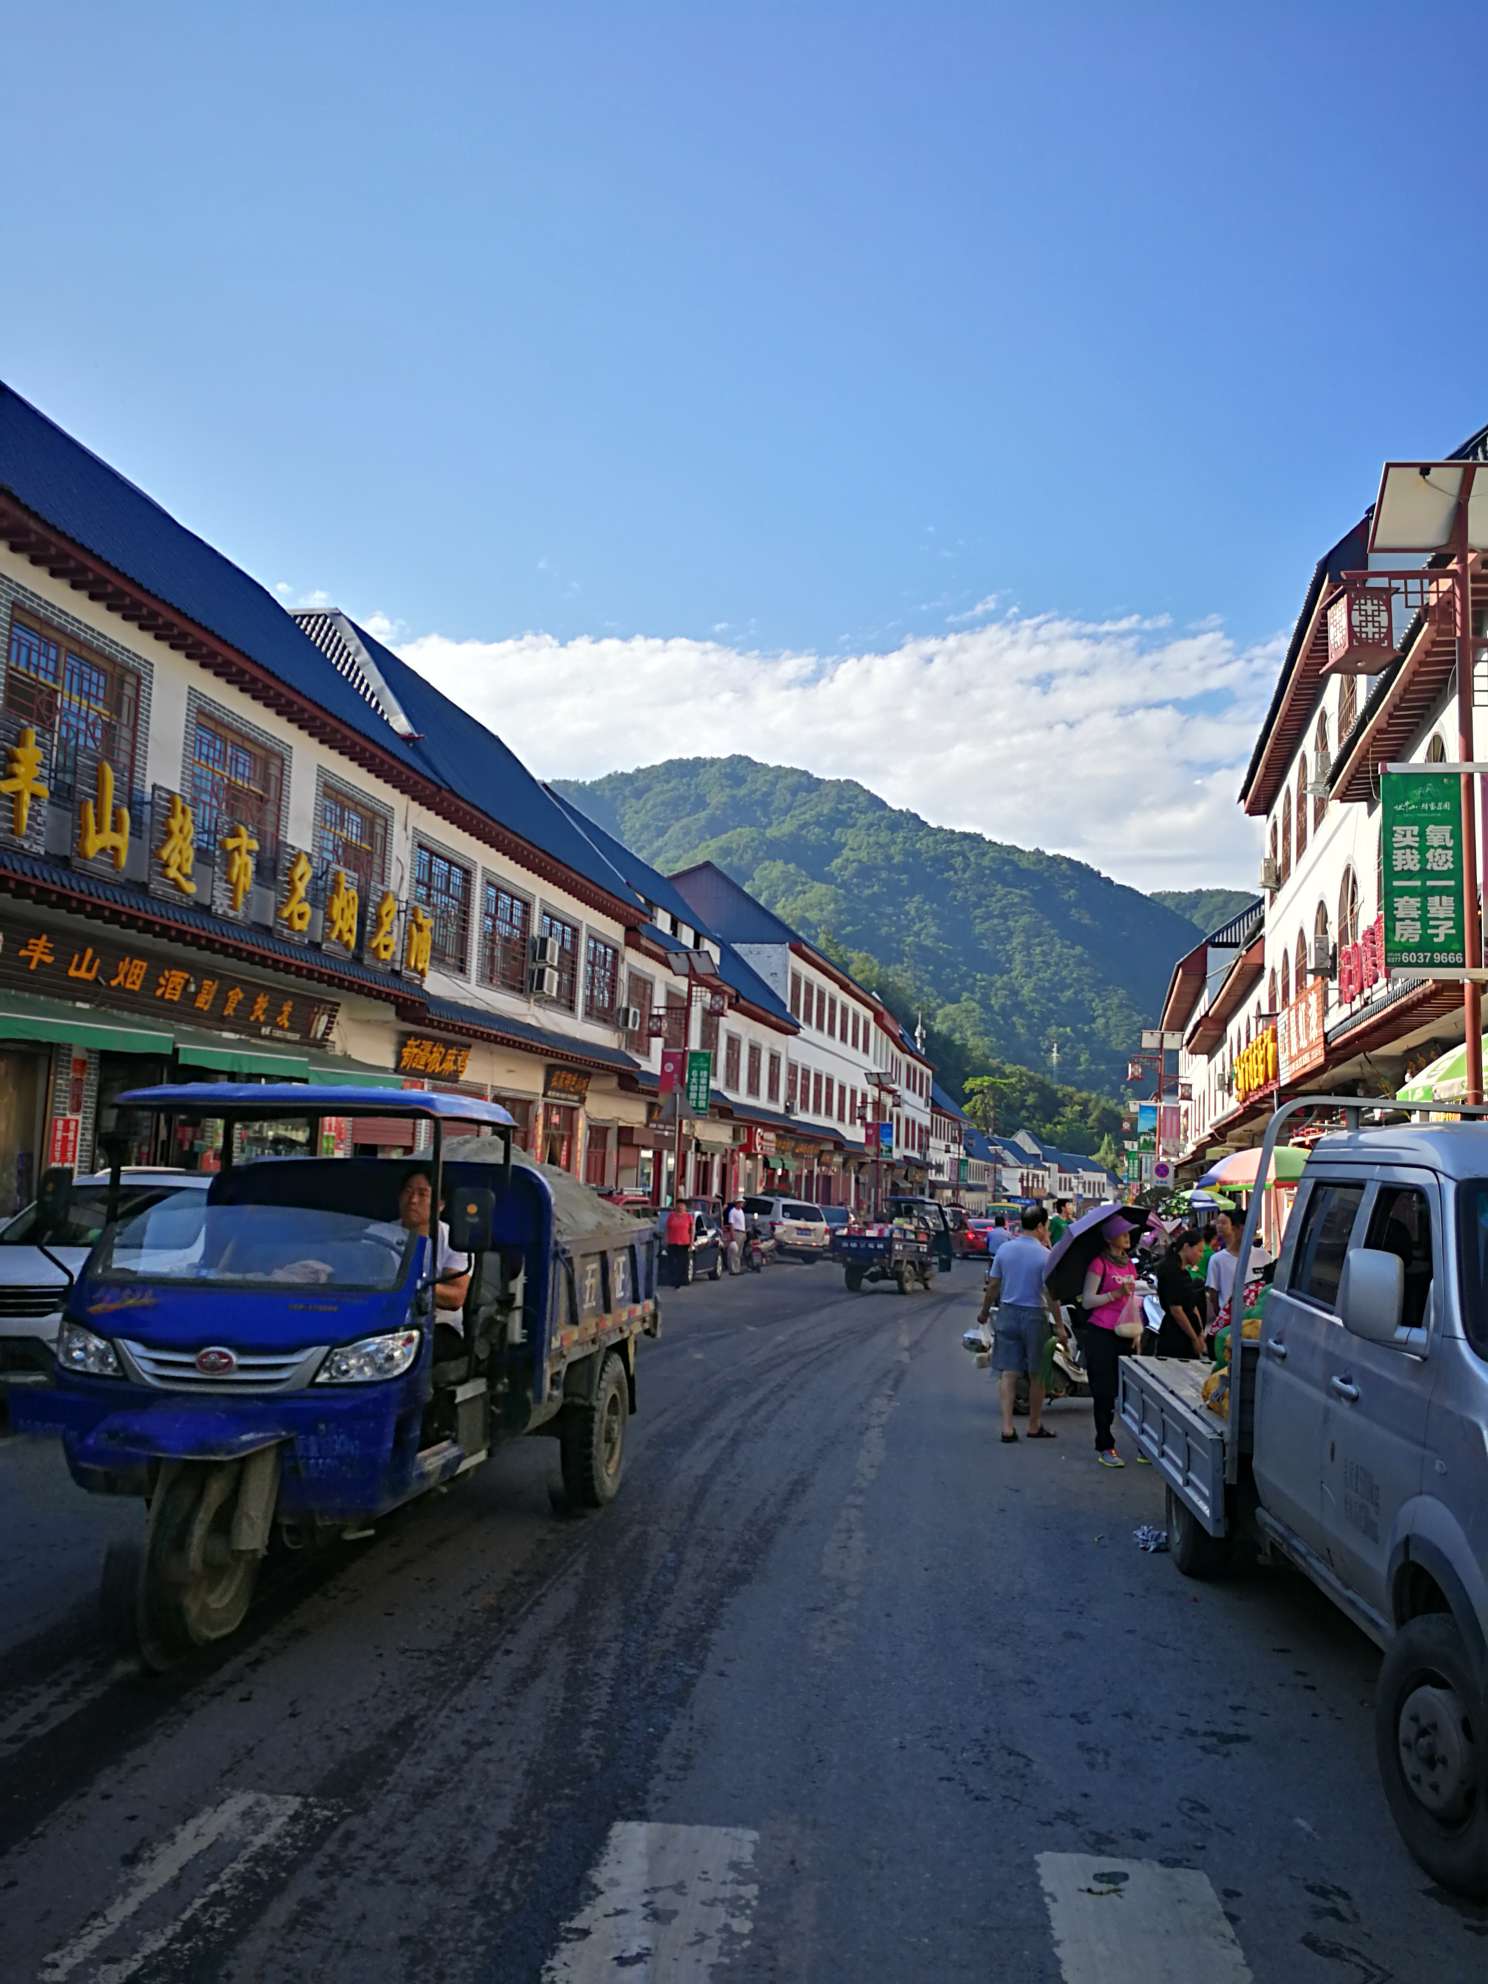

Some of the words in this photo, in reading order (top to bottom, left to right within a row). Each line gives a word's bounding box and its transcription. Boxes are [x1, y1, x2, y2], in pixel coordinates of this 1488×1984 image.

[0, 726, 433, 978] 丰山超市名烟名酒
[1392, 825, 1422, 943] 买我一套房
[1425, 824, 1456, 943] 氧您一辈子
[18, 933, 294, 1029] 丰山烟酒副食批发
[1401, 952, 1431, 964] 6037
[1433, 952, 1463, 964] 9666
